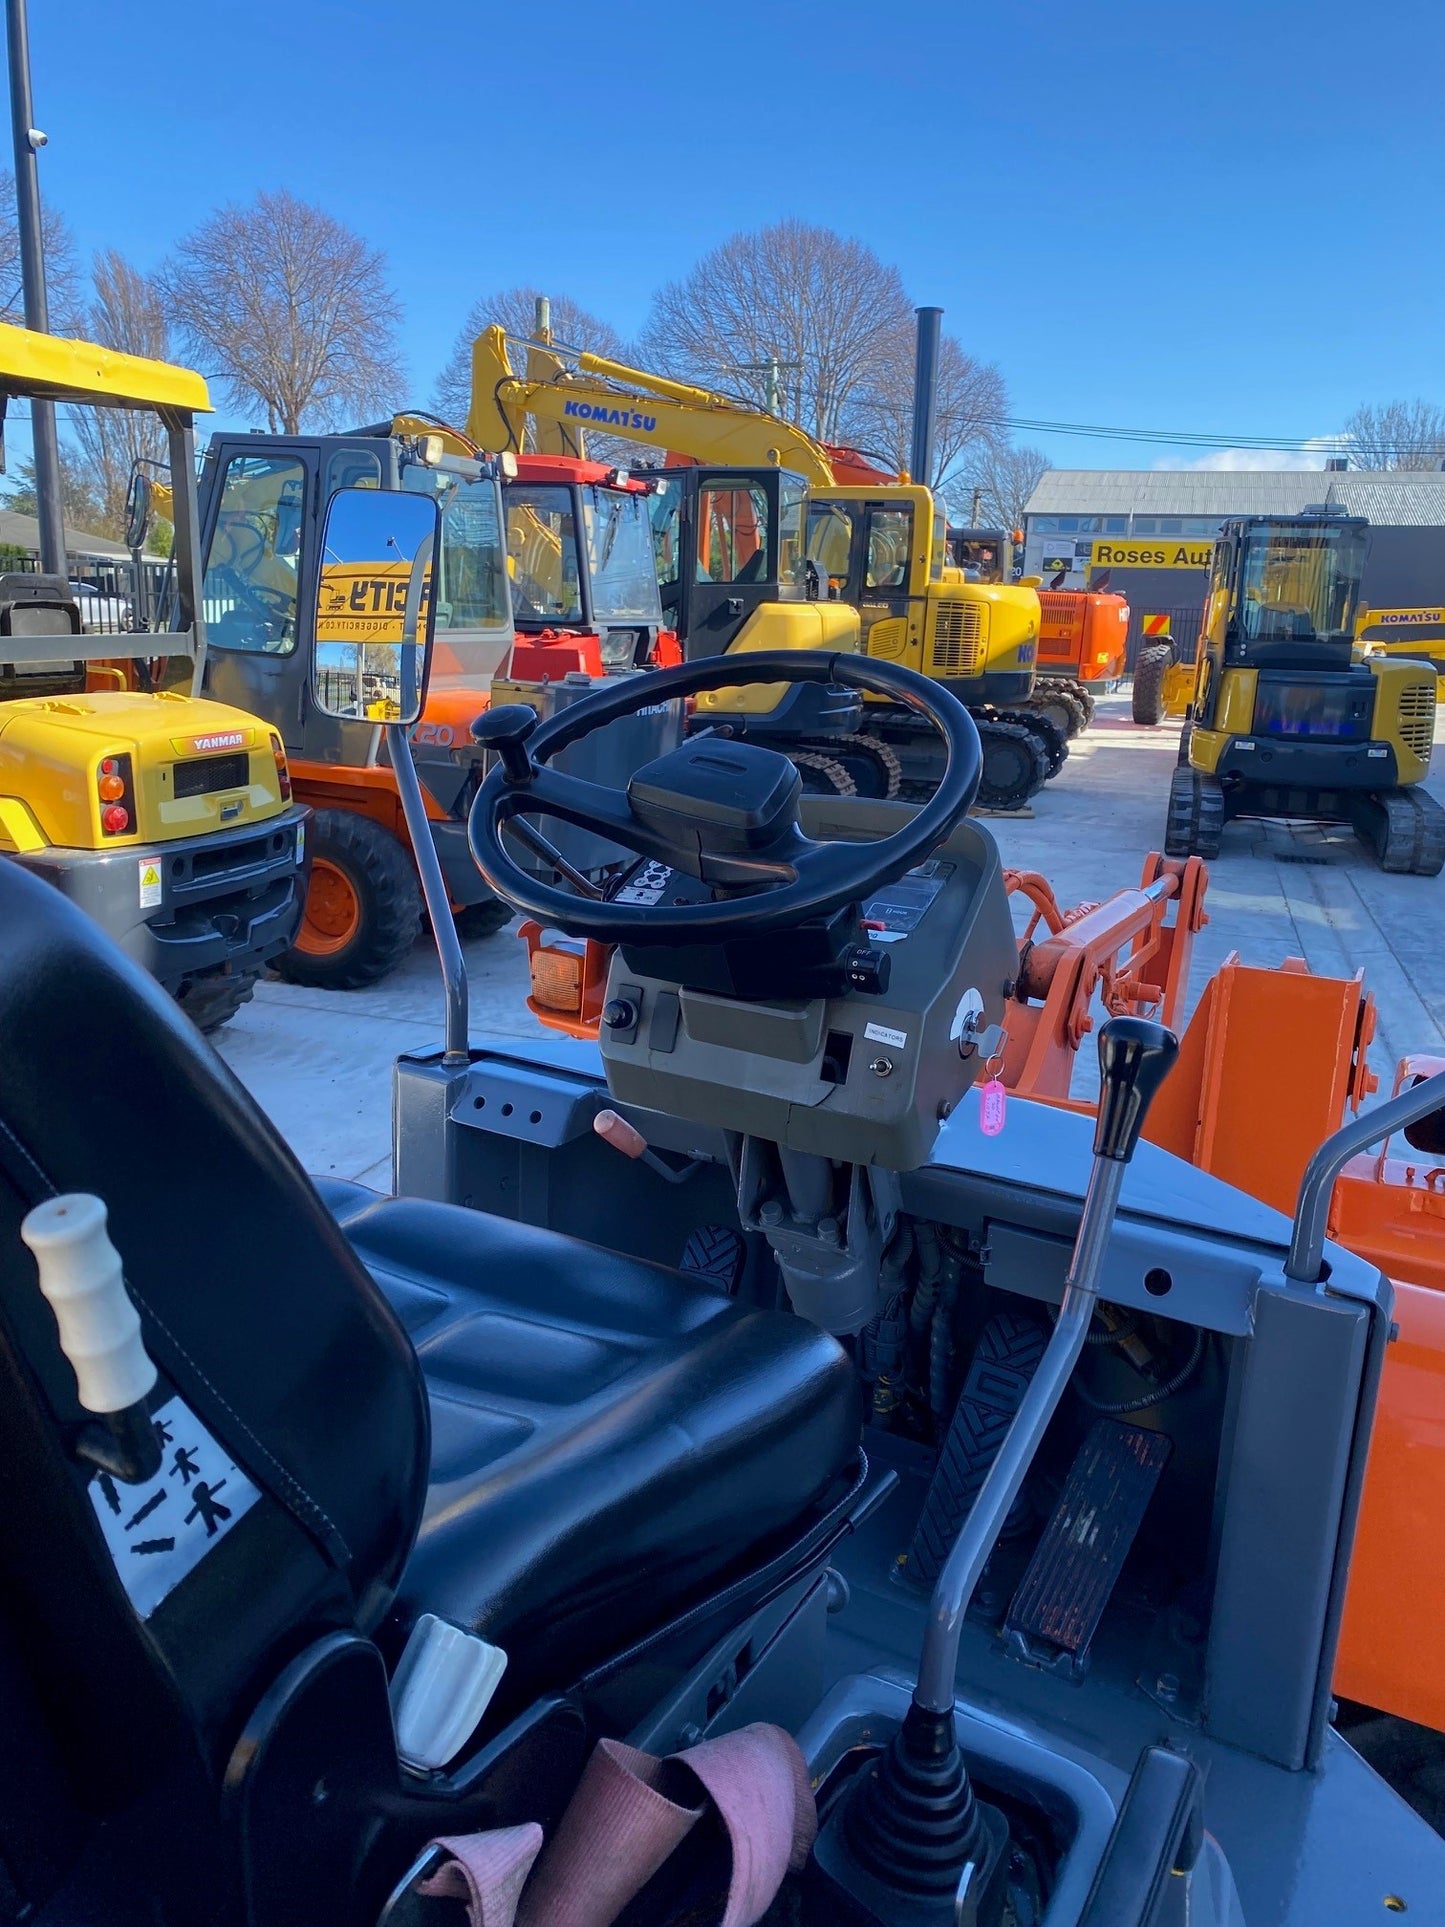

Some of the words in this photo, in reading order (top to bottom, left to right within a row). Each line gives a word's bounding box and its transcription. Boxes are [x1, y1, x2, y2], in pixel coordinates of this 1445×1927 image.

[564, 400, 657, 432] KOMATSU
[1097, 546, 1166, 563] Roses
[1381, 611, 1440, 623] KOMATSU
[193, 734, 243, 750] YANMAR
